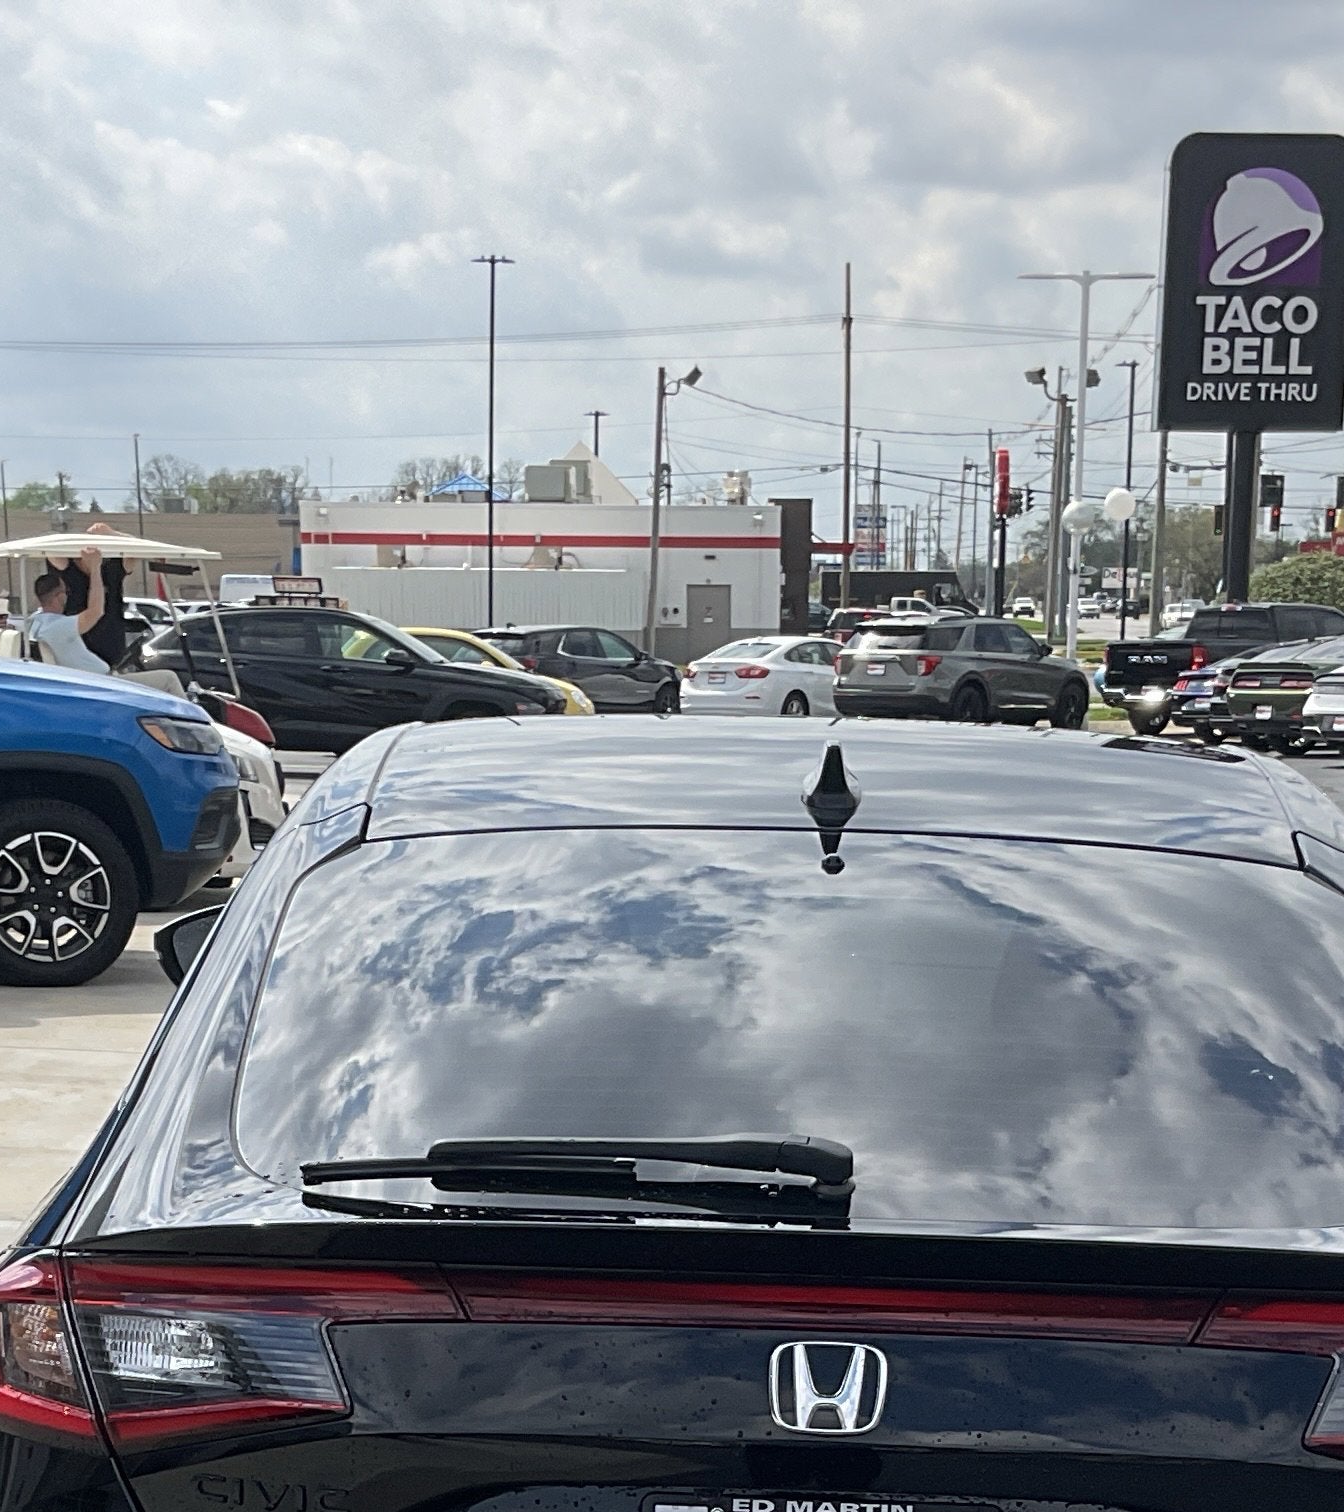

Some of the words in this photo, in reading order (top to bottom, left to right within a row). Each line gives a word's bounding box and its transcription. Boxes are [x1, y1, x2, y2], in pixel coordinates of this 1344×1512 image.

[1196, 296, 1318, 333] TACO
[1202, 337, 1313, 375] BELL
[1186, 382, 1251, 401] DRIVE
[1257, 382, 1317, 402] THRU
[1127, 655, 1168, 664] RAM
